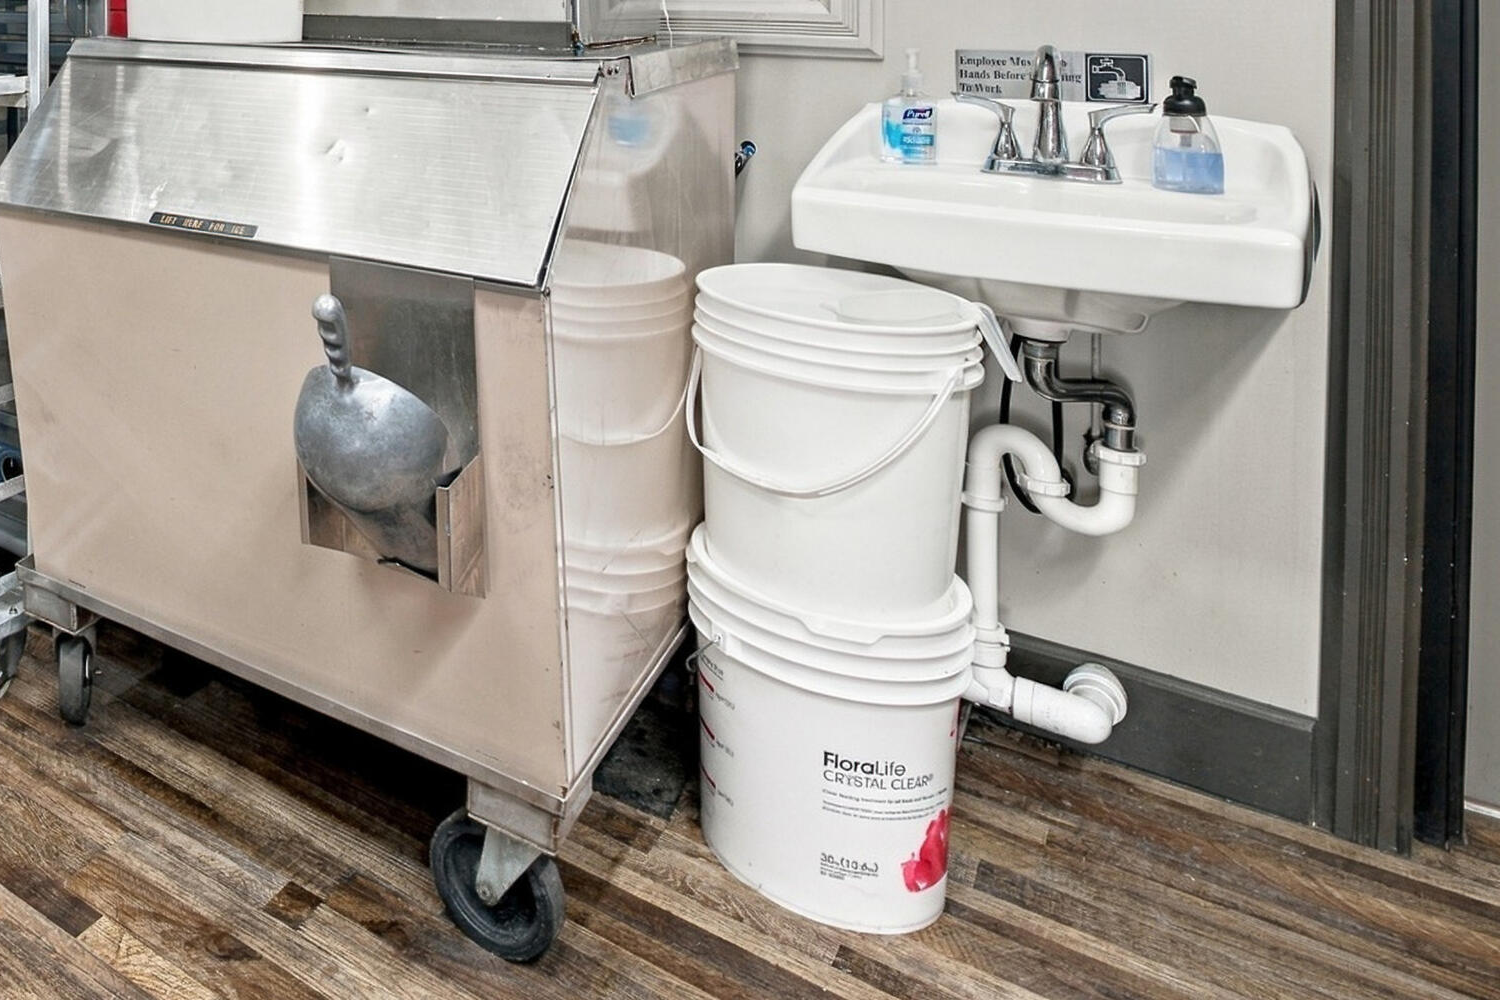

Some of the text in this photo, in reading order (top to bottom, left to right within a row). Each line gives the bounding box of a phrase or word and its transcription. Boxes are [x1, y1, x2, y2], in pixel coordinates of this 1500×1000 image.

[959, 55, 1032, 67] Employee Mus
[959, 69, 991, 80] Hands
[993, 70, 1026, 80] Before
[959, 82, 1003, 94] To Work
[160, 215, 245, 234] LIFT HERE FOR ICE
[823, 750, 907, 777] FloraLife
[823, 769, 888, 791] CRYSTAL
